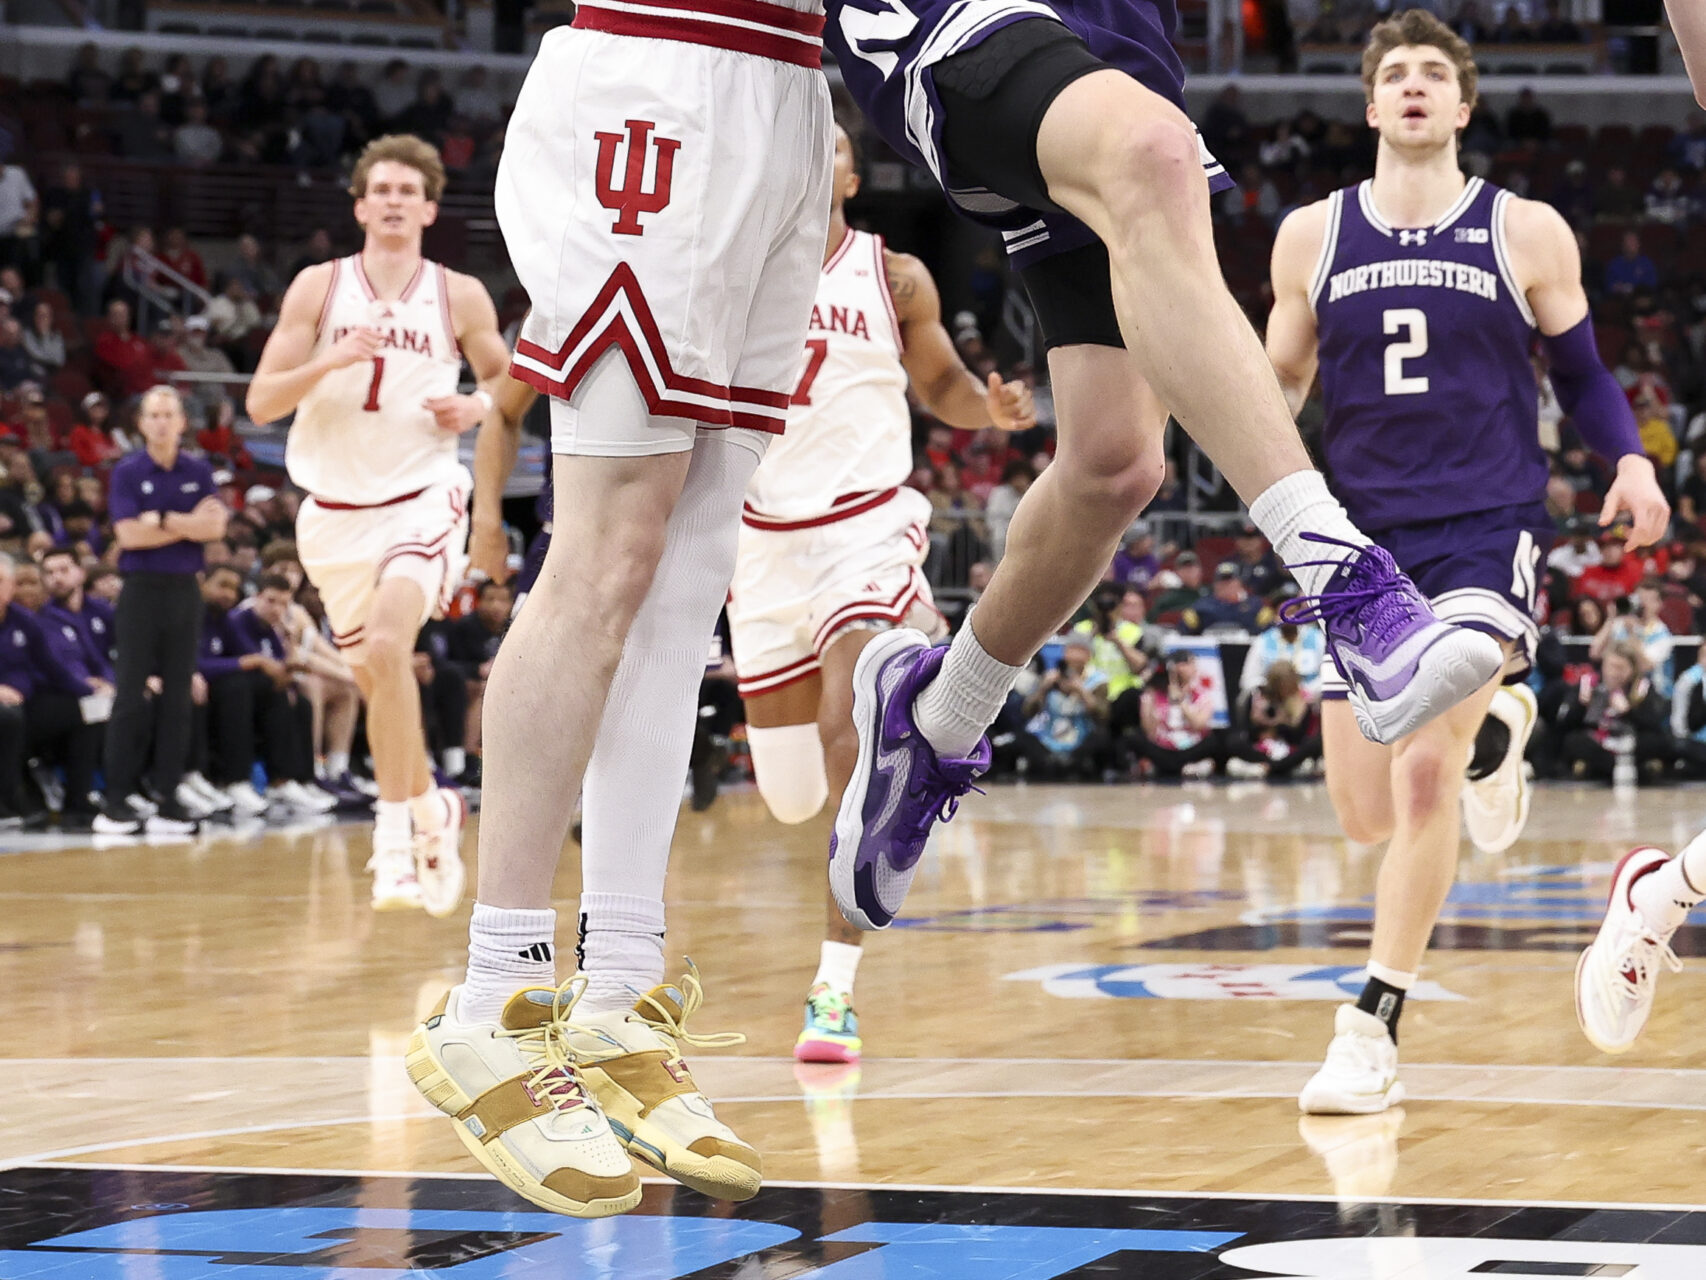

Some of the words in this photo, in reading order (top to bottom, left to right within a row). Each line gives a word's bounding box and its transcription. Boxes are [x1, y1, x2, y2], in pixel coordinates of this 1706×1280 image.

[1328, 259, 1498, 303] NORTHWESTERN
[1383, 308, 1429, 395] 2
[362, 356, 385, 412] 1
